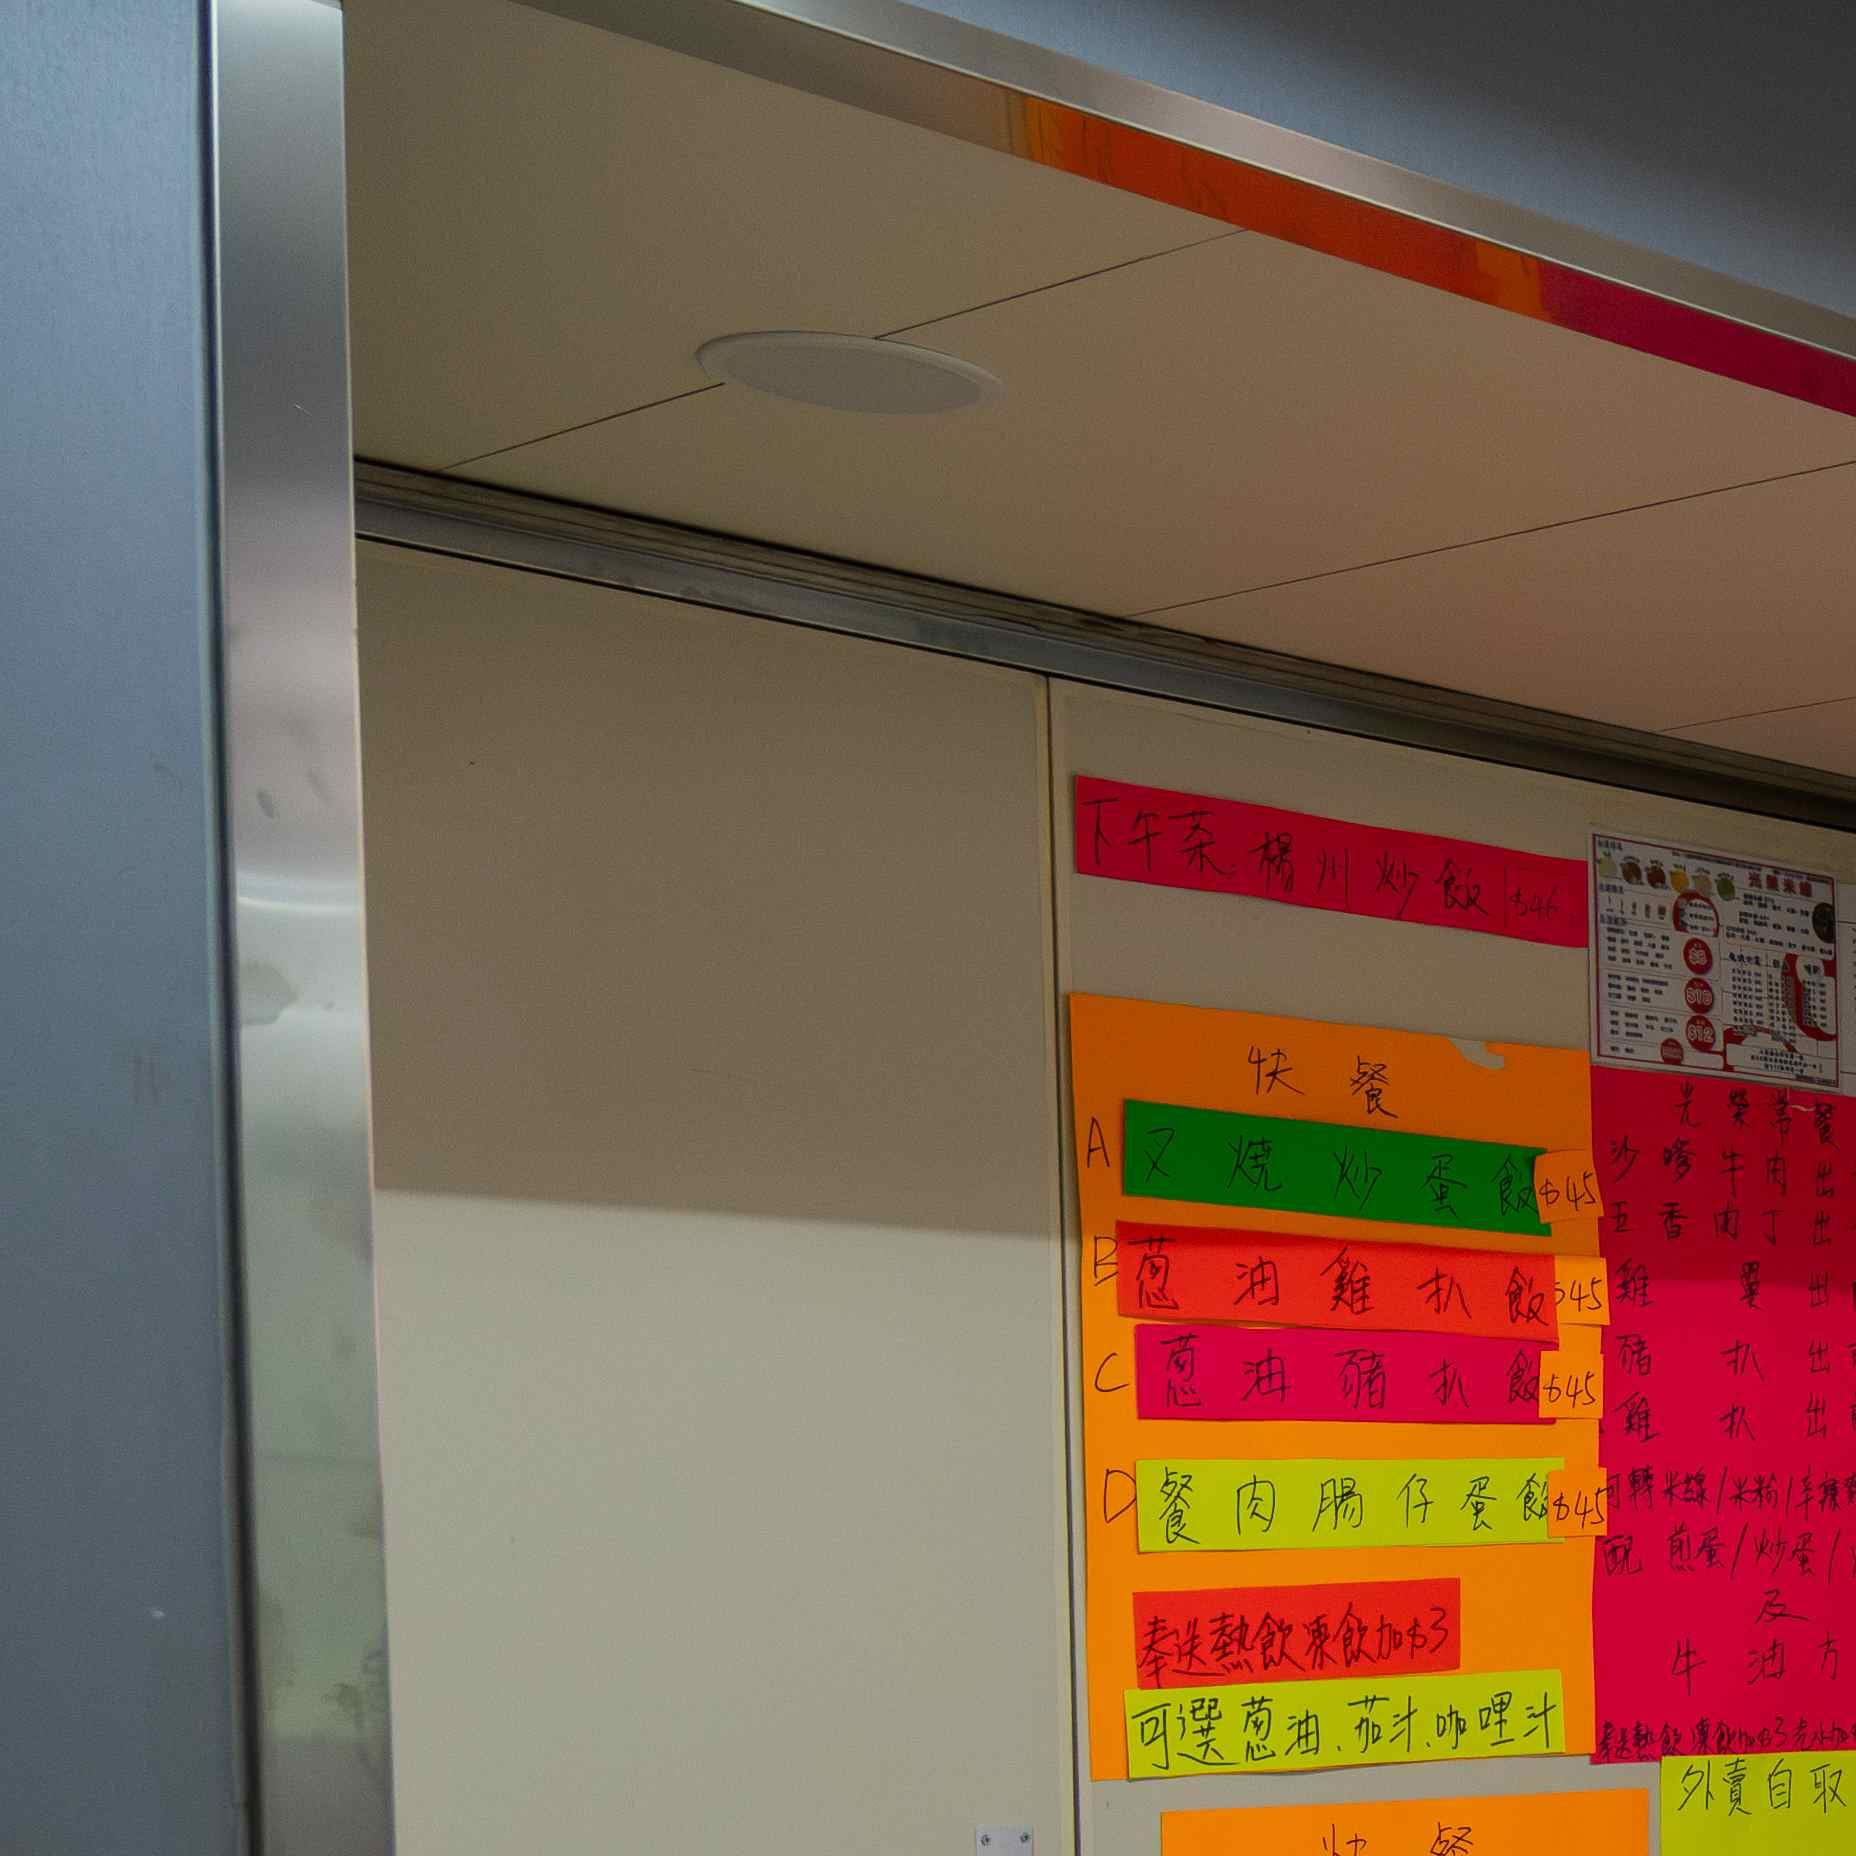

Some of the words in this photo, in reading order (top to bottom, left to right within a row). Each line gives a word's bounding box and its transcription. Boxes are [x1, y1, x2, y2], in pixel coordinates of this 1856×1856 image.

[1248, 1044, 1398, 1118] 快餐
[1086, 1117, 1110, 1168] A
[1145, 1127, 1536, 1218] 叉燒炒蛋飯
[1539, 1170, 1598, 1206] $45
[1094, 1352, 1130, 1393] C
[1542, 1372, 1597, 1407] $45
[1104, 1469, 1137, 1523] D
[1553, 1484, 1606, 1527] $45
[1676, 1760, 1850, 1819] 外賣自取
